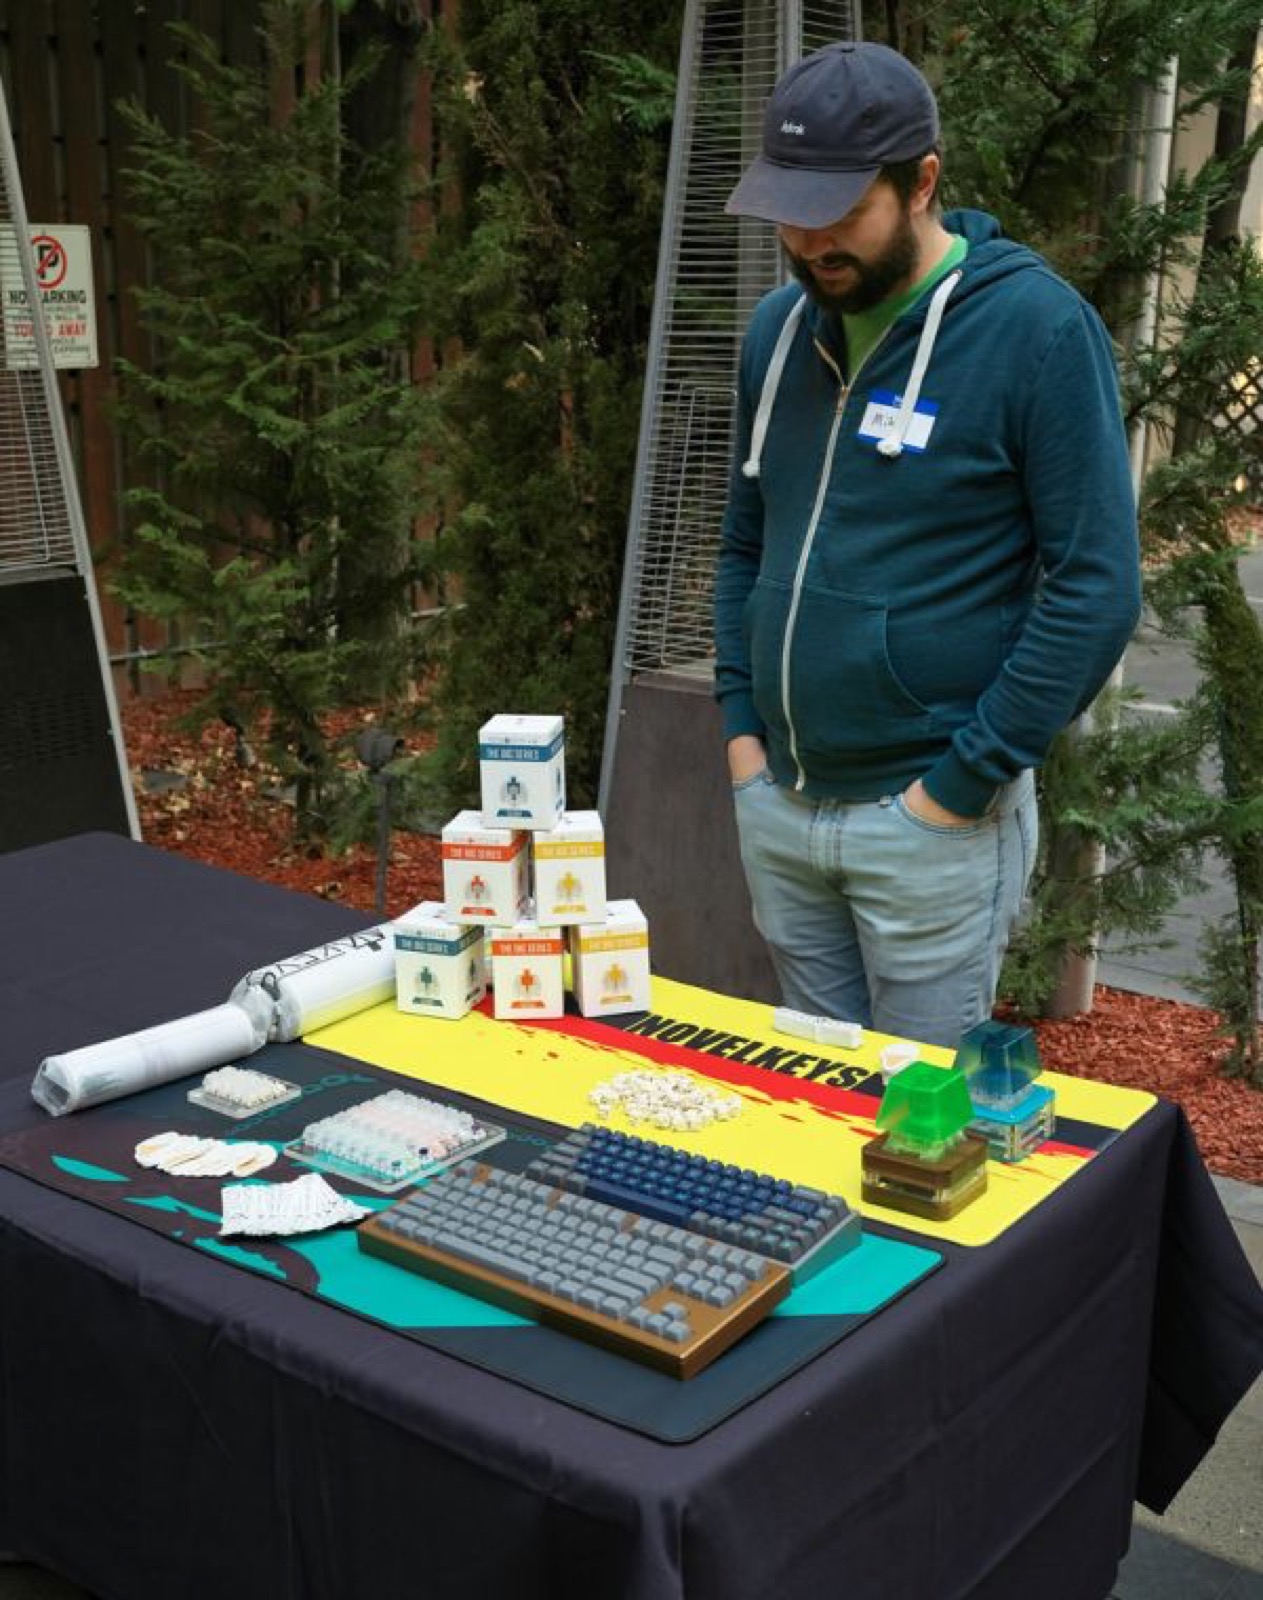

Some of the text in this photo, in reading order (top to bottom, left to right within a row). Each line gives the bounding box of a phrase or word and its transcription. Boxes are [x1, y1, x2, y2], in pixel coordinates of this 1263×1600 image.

[9, 289, 87, 304] NO ARKING
[58, 322, 87, 337] AWAY
[628, 1014, 868, 1089] NOVELKEYS
